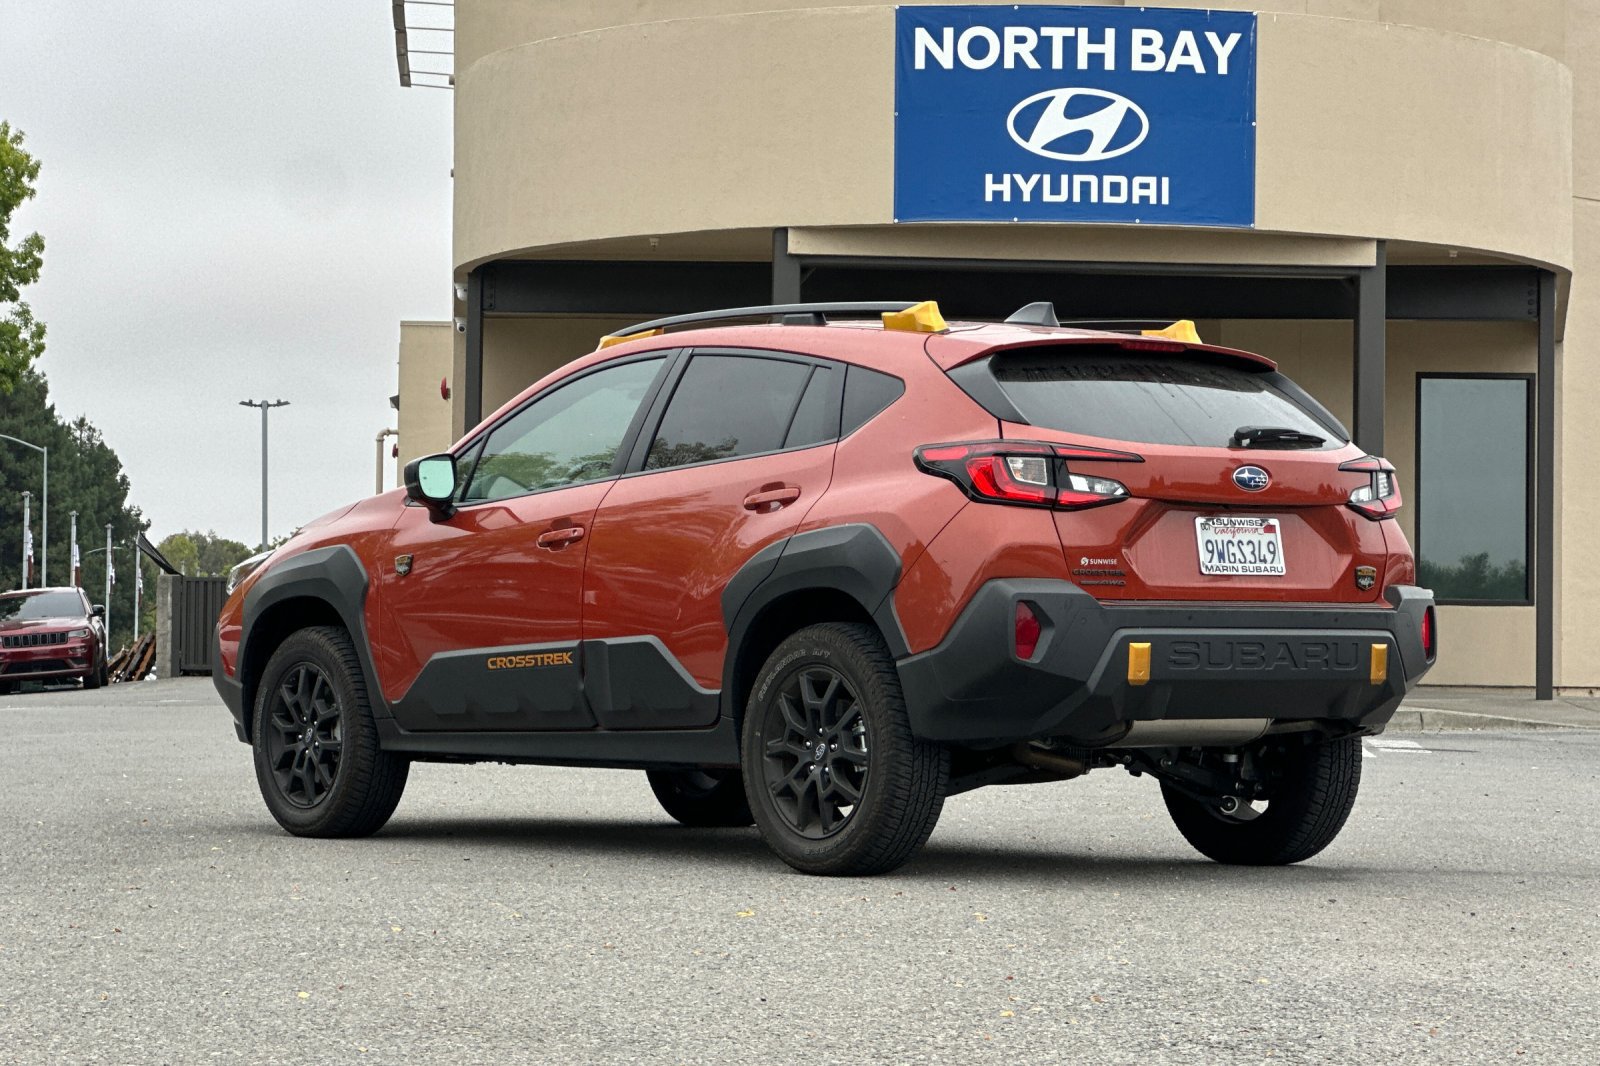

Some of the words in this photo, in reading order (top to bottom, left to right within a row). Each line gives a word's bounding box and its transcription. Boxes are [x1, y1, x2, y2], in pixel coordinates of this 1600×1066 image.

[914, 26, 1116, 70] NORTH
[1131, 28, 1242, 75] BAY
[985, 173, 1169, 205] HYUNDAI
[1213, 527, 1258, 538] California
[1215, 518, 1261, 527] SUNWISE
[1205, 539, 1277, 564] 9WGS349
[1205, 565, 1239, 573] MARIN
[1241, 565, 1284, 573] SUBARU
[487, 651, 573, 669] CROSSTREK
[1168, 641, 1360, 671] SUBARU
